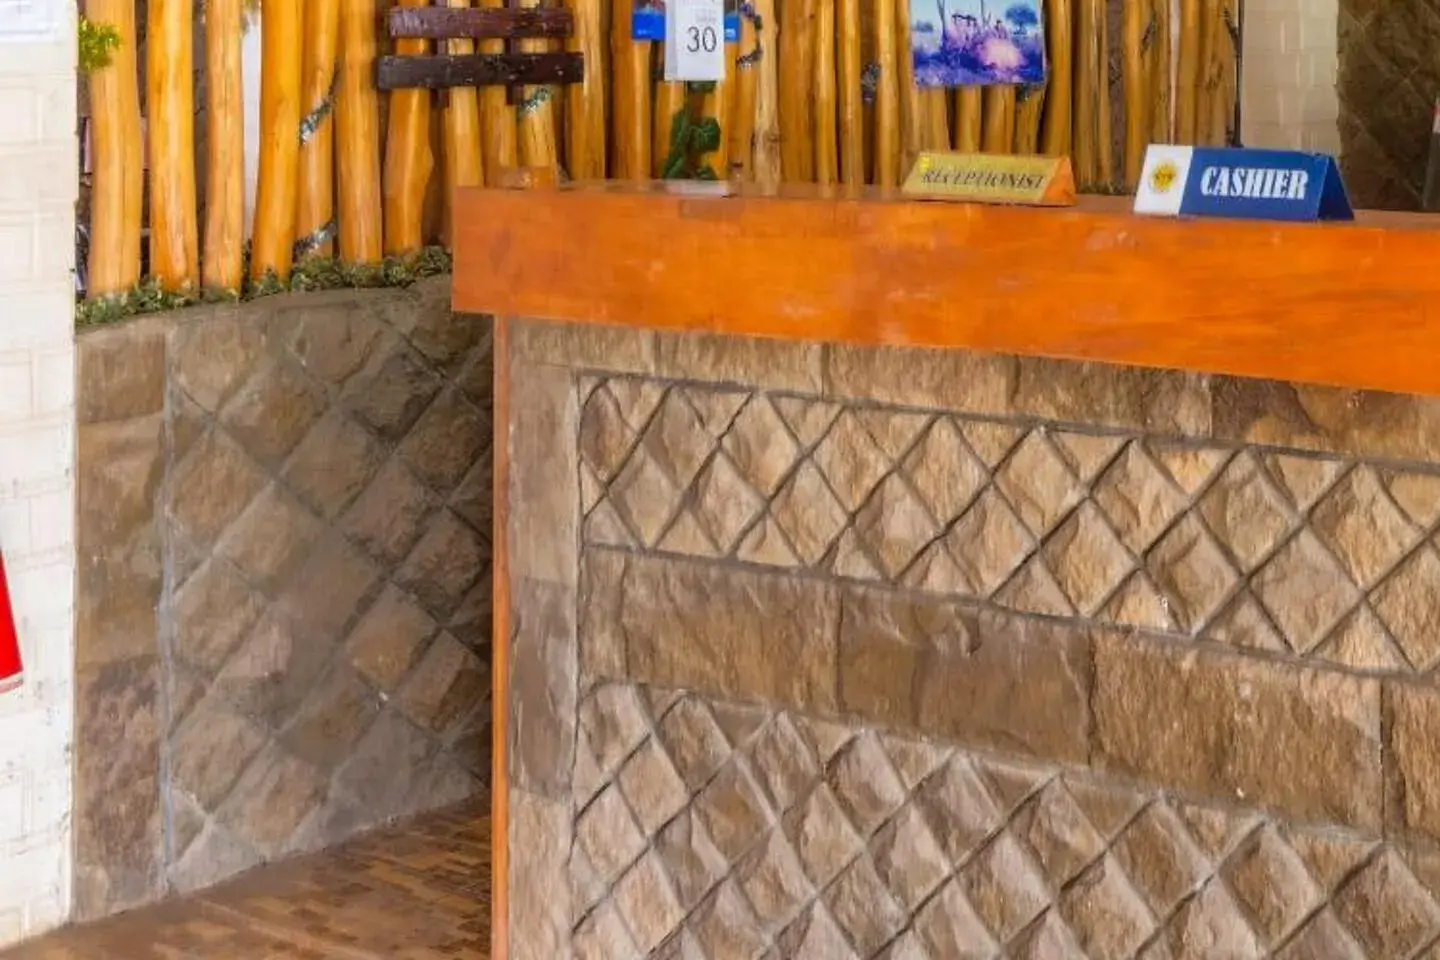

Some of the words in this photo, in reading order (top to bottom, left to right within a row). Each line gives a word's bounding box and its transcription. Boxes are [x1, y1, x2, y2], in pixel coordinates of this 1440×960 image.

[687, 26, 717, 53] 30
[921, 168, 1044, 190] RECEPTIONIST
[1200, 165, 1309, 201] CASHIER
